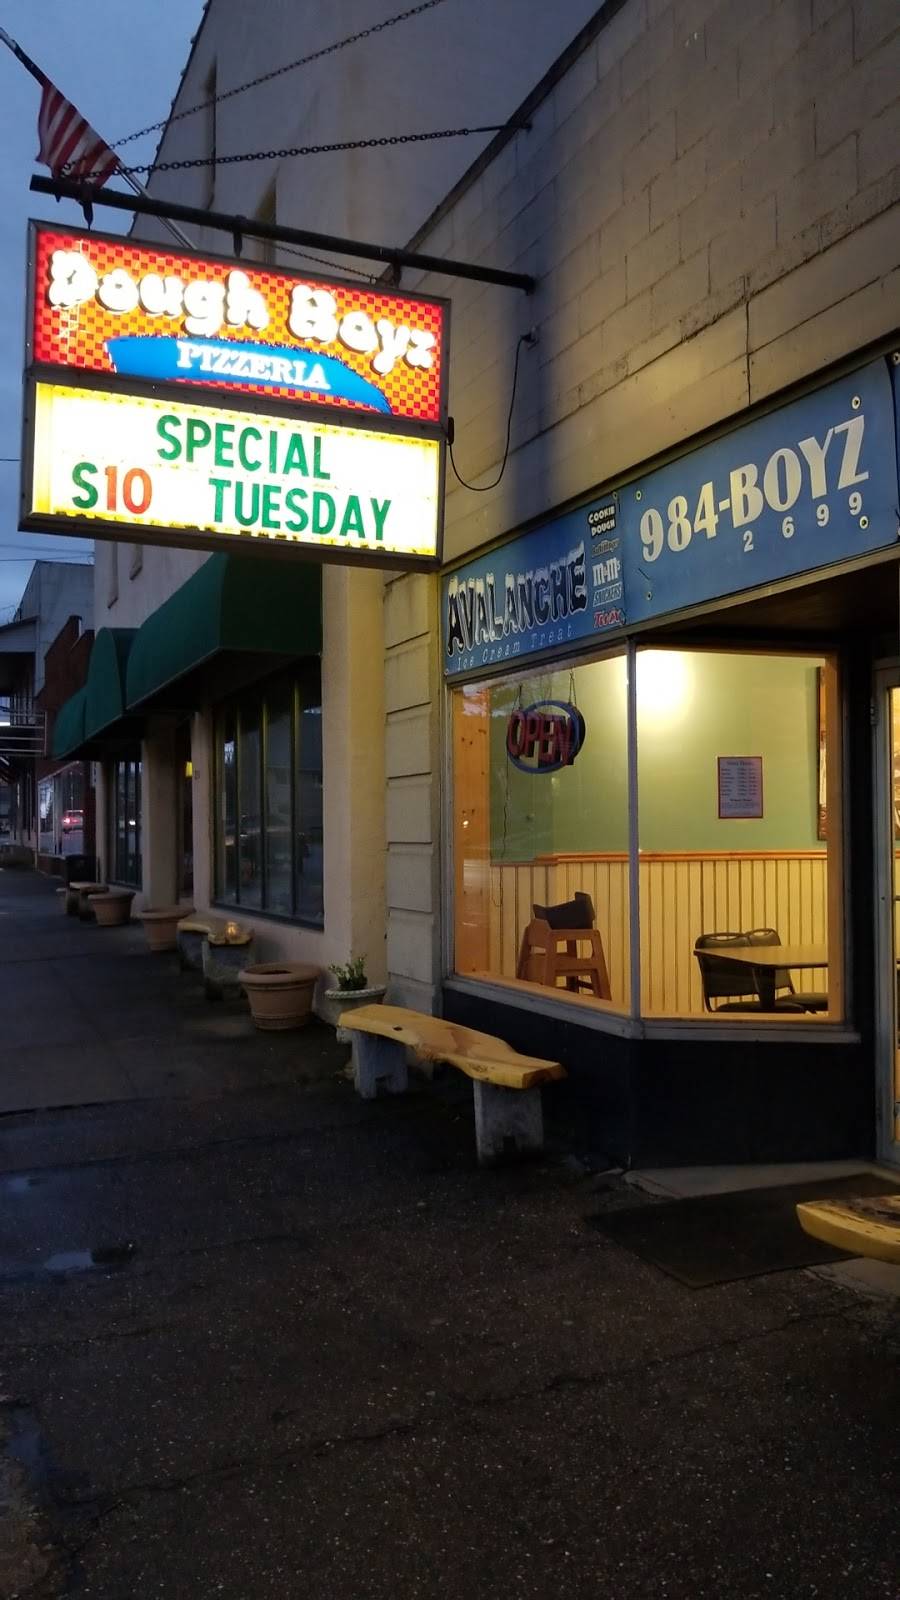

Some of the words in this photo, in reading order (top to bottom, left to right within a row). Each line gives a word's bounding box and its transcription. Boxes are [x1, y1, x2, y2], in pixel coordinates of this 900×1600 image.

[49, 249, 270, 337] Dough
[288, 284, 438, 376] Boyz
[176, 340, 332, 391] PIZZERIA
[156, 414, 331, 481] SPECIAL
[209, 477, 392, 541] TUESDAY
[588, 505, 615, 524] COOKIE
[639, 414, 869, 563] 984-BOYZ
[591, 518, 616, 537] DOUGH
[447, 540, 588, 657] AVALANCHE
[457, 656, 474, 672] Ice
[482, 642, 520, 663] Cream
[530, 624, 572, 649] Treat
[506, 709, 574, 768] OPEN
